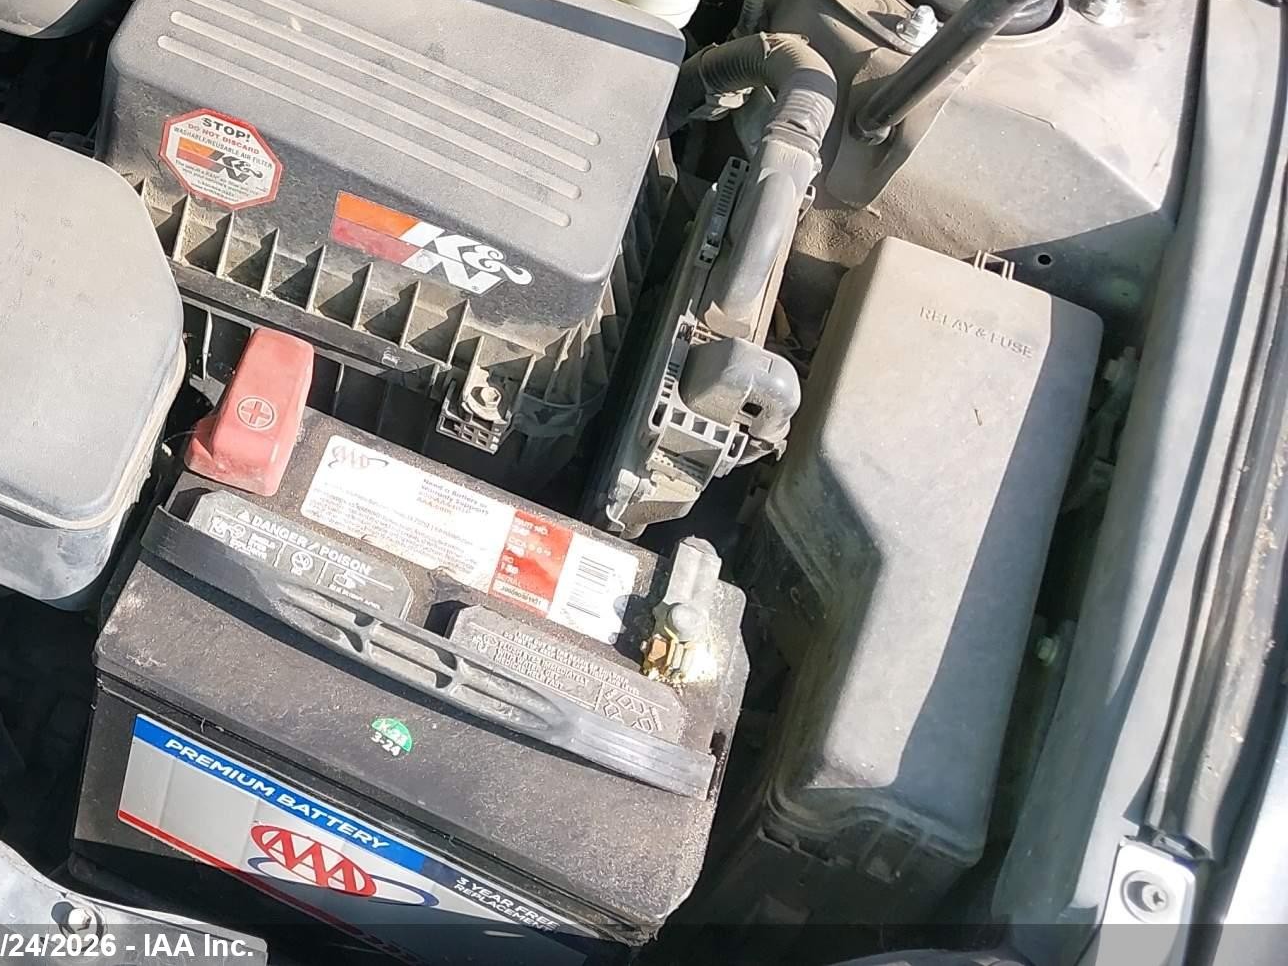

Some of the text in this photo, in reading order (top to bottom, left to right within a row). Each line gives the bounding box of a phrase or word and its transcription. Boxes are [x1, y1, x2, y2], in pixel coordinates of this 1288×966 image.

[188, 124, 260, 154] DO NOT DISCARD
[202, 117, 250, 142] STOP!
[920, 306, 1032, 358] RELAY & FUSE
[252, 516, 307, 548] DANGER
[320, 545, 372, 575] POISON
[370, 731, 402, 756] 3-24
[165, 738, 390, 849] PREMIUM BATTERY
[260, 829, 364, 894] AAA
[453, 883, 557, 933] REPLACEMENT
[456, 876, 562, 929] 3 YEAR FREE
